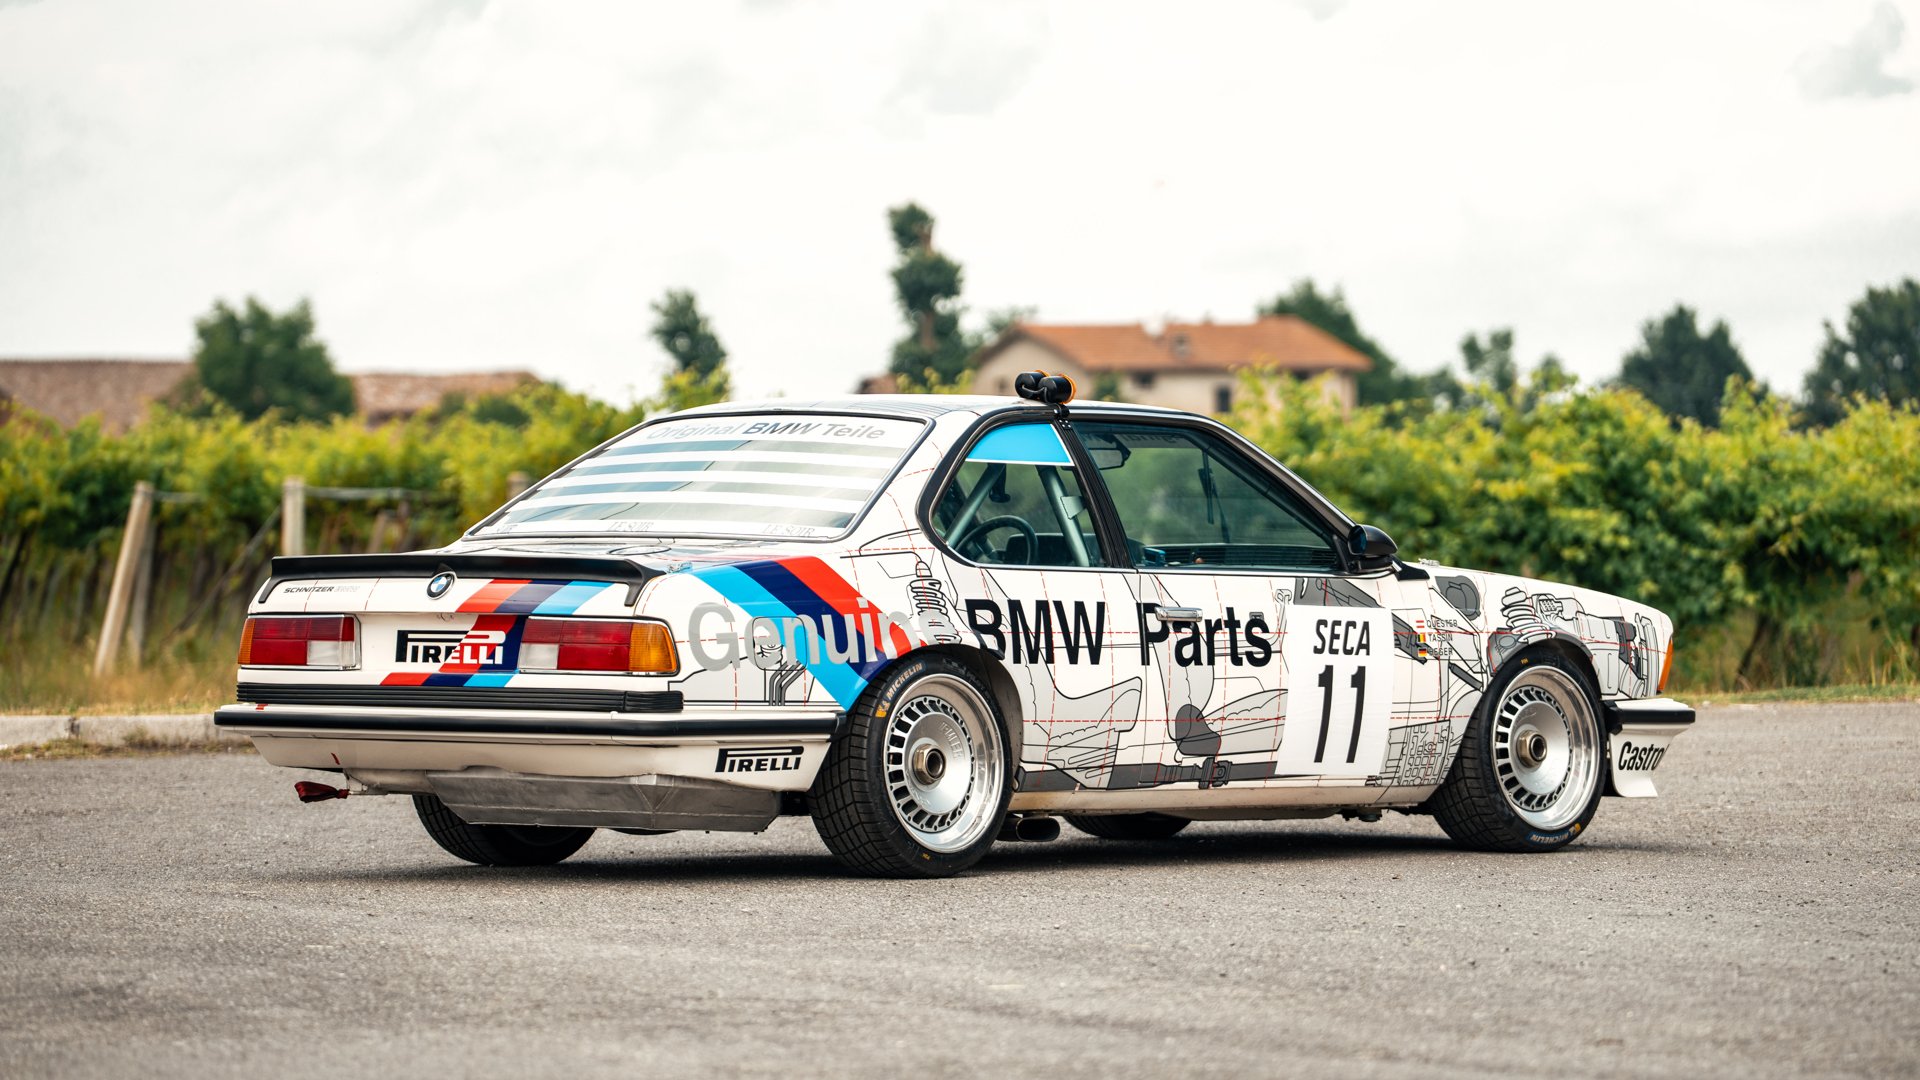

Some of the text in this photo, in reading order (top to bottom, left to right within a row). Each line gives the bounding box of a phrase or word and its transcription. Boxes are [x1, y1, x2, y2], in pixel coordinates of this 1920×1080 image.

[647, 422, 886, 440] Original BMW Teile
[283, 586, 335, 594] SCHNITZER
[395, 630, 506, 665] PIRELLI
[964, 598, 1106, 665] BMW
[1136, 602, 1272, 667] Parts
[1313, 619, 1370, 656] SECA
[886, 662, 924, 700] MICHELIN
[1314, 665, 1366, 763] 11
[715, 746, 804, 773] PIRELLI
[1618, 741, 1670, 771] Castro
